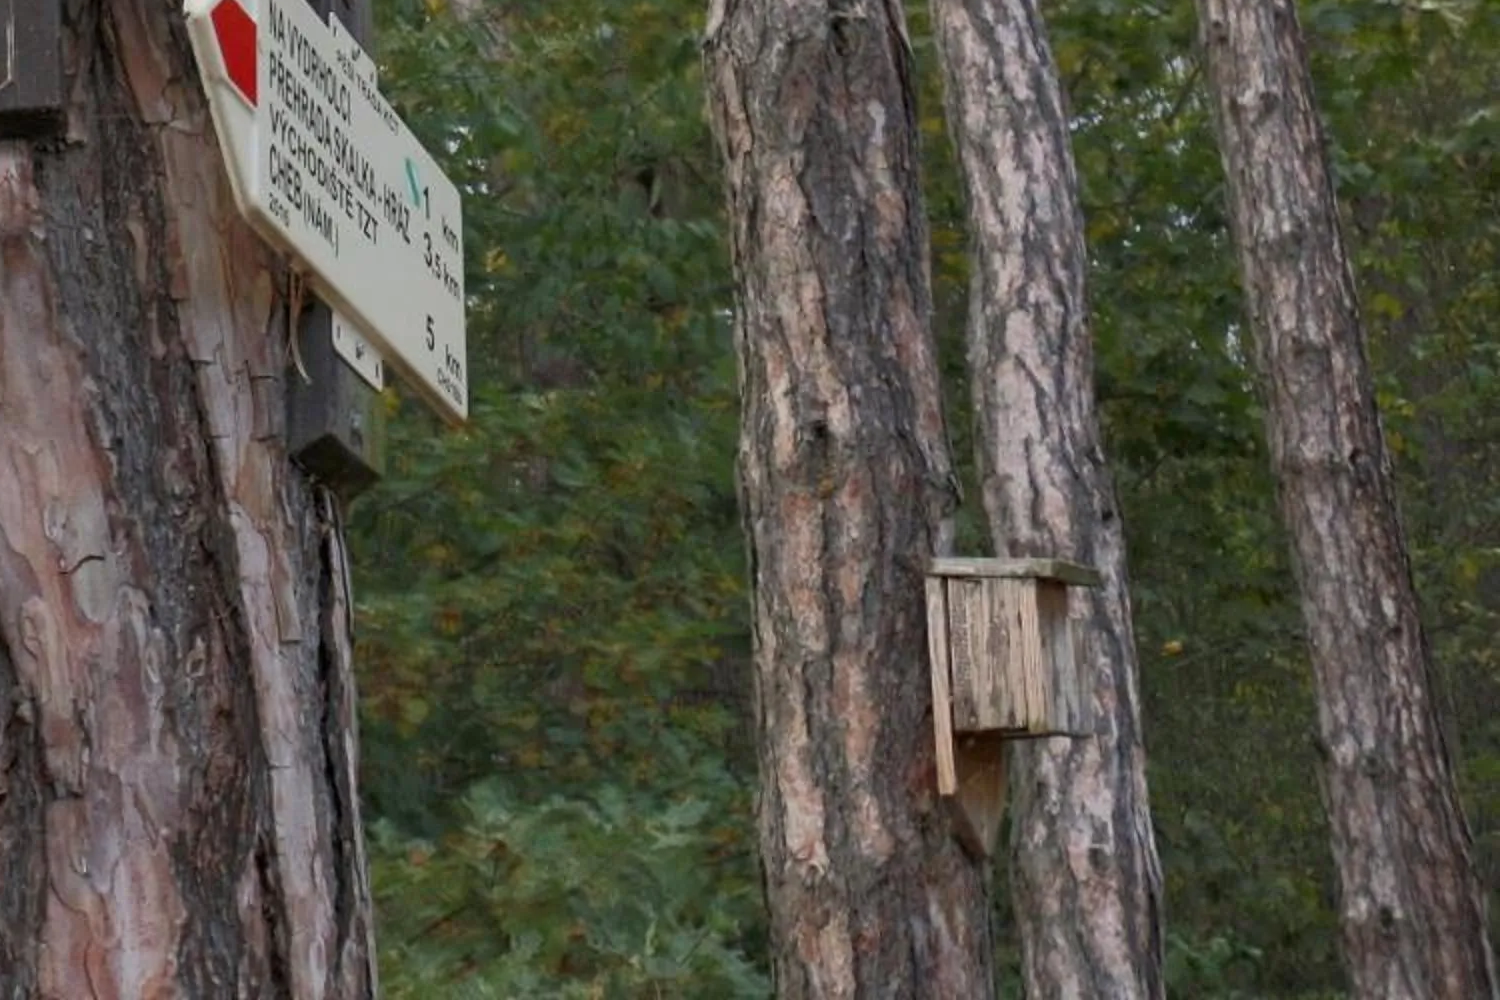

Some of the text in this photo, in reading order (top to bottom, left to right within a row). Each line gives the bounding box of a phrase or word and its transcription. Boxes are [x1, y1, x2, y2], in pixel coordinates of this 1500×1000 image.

[269, 51, 332, 155] PŘEHRADA
[334, 127, 376, 206] SKALKA
[443, 262, 460, 301] km
[288, 16, 350, 126] VYDRHOLCI
[441, 215, 459, 253] km
[356, 200, 378, 245] TZT
[269, 144, 302, 212] CHEB
[445, 344, 462, 381] km
